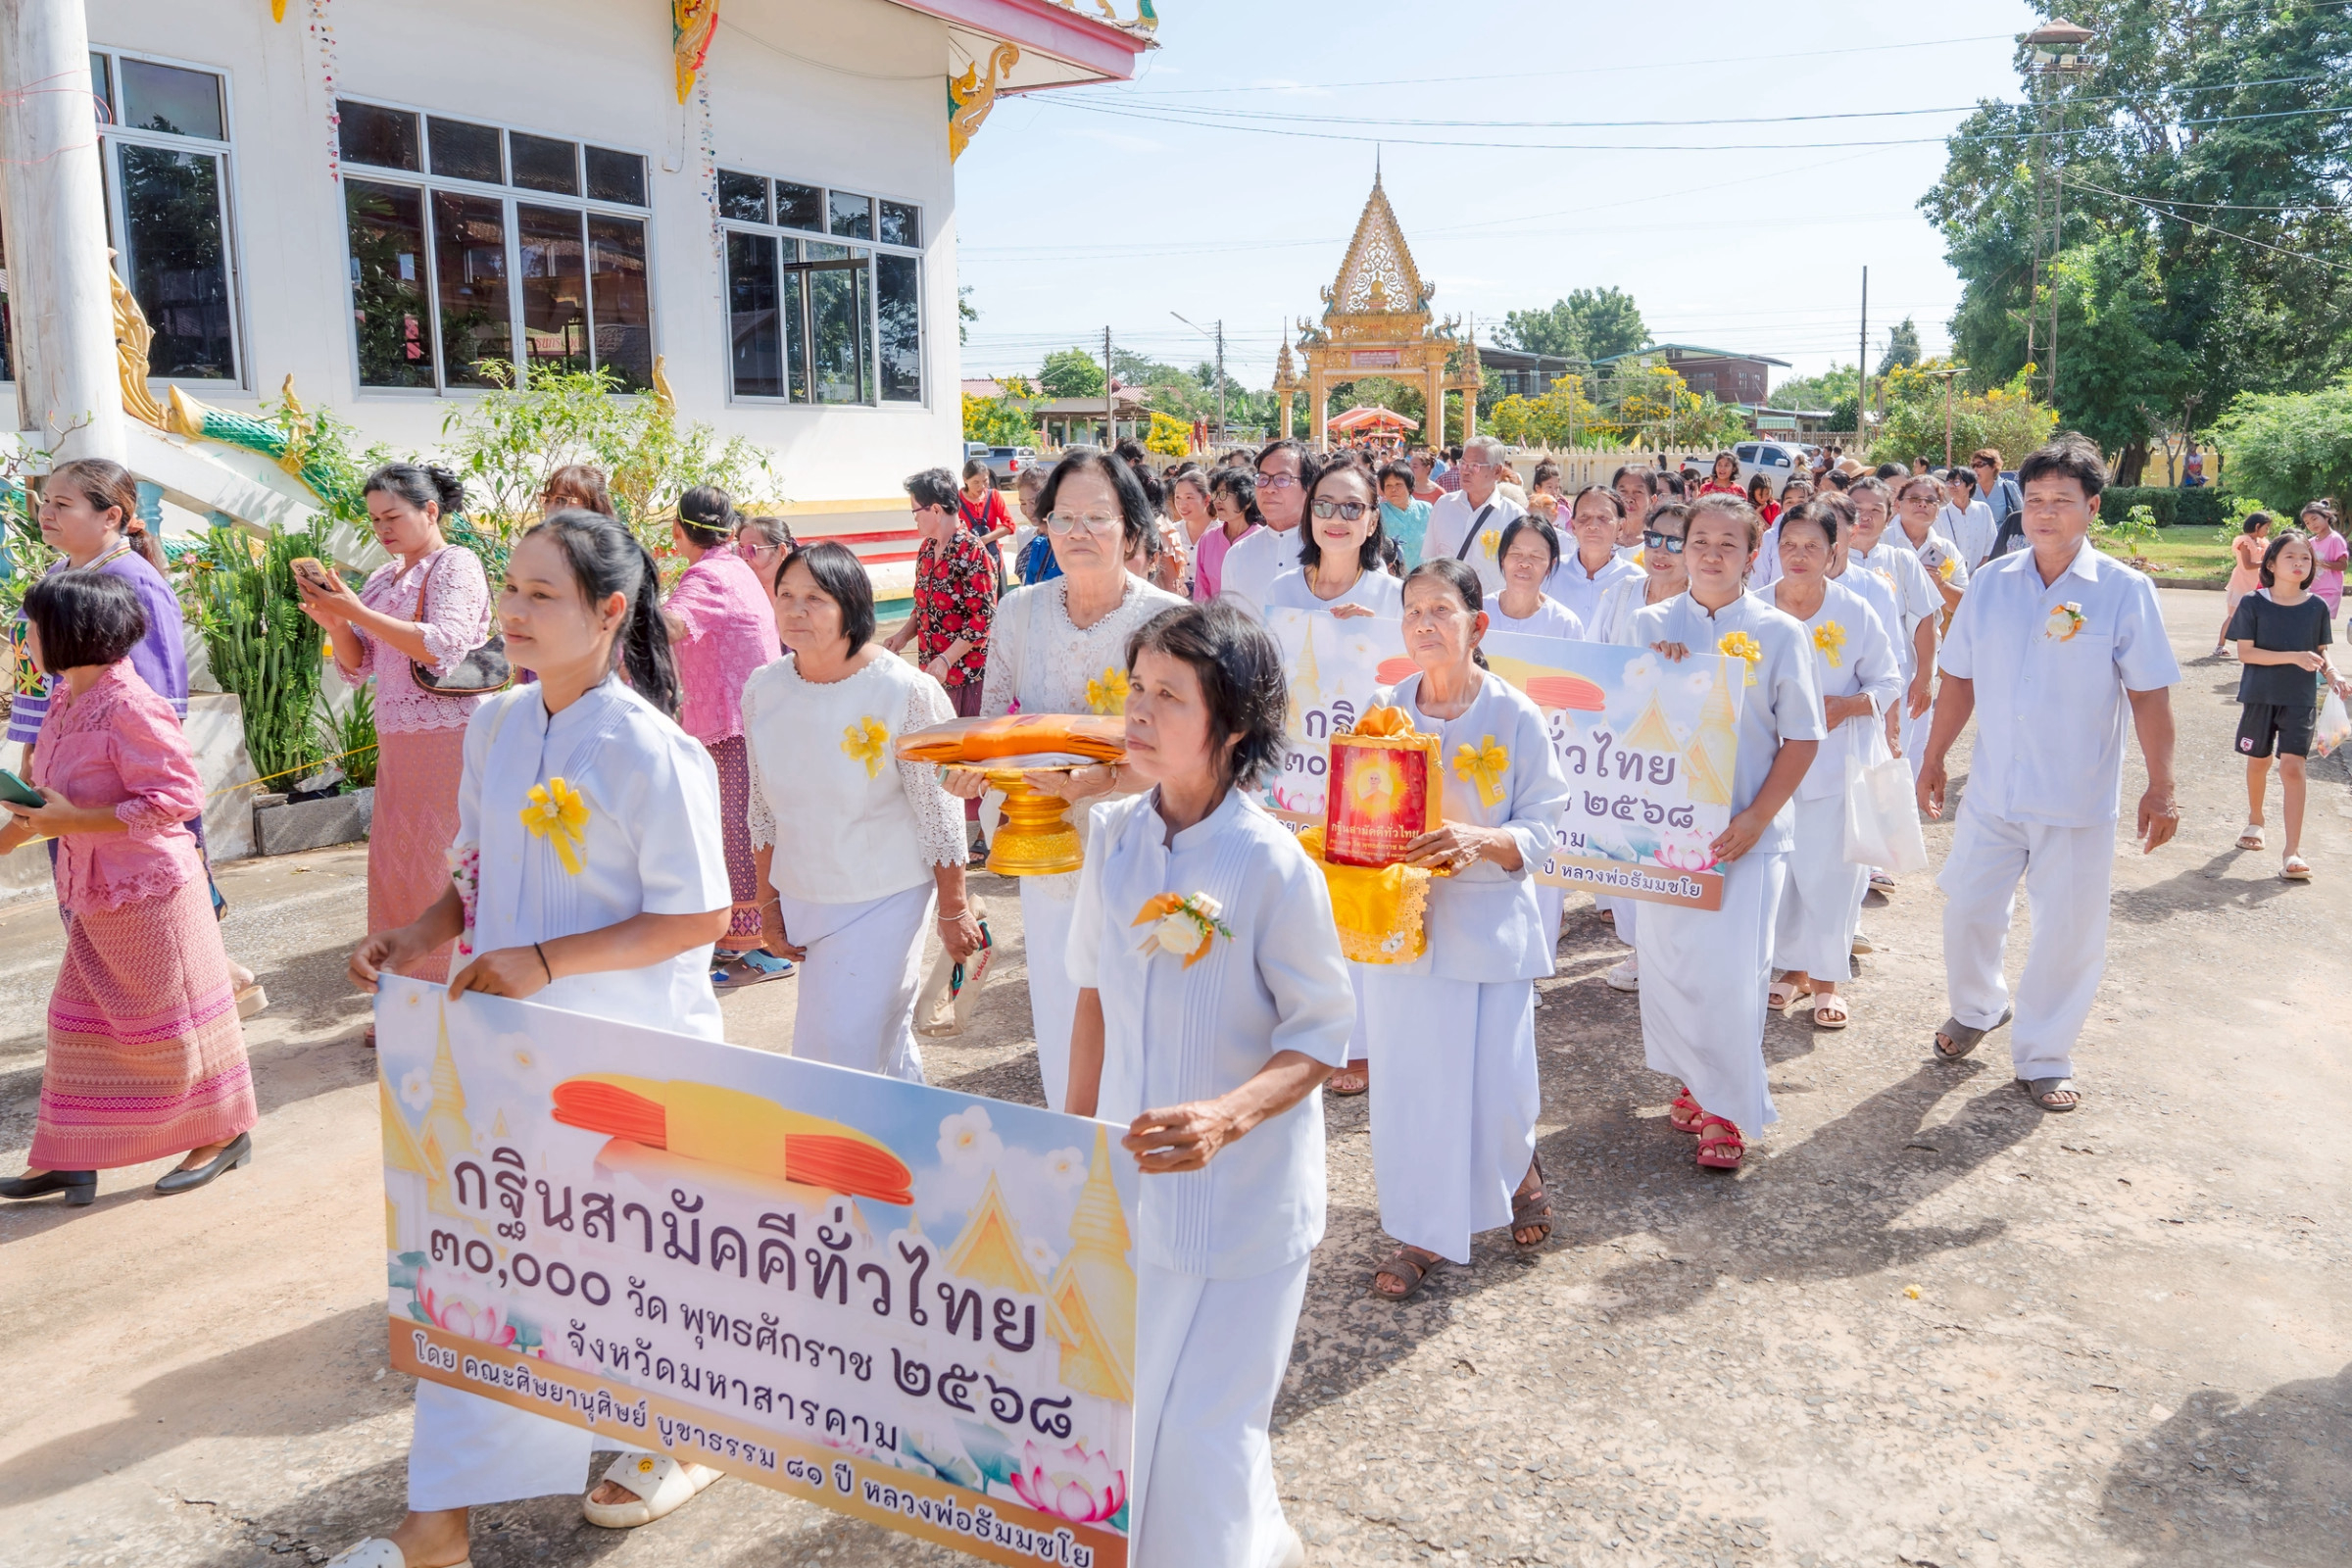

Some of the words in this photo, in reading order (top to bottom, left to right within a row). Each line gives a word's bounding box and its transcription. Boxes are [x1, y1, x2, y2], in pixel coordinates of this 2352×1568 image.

[1584, 790, 1694, 829] ๒๕๖๘
[1562, 864, 1700, 896] หลวงพ่อธัมมชโย
[971, 950, 991, 981] Yakult
[454, 1146, 1035, 1352] กฐินสามัคคีทั่วไทย
[431, 1229, 611, 1306] ๓๐,๐๐๐
[627, 1275, 667, 1324] วัด
[680, 1301, 872, 1382] พุทธศักราช
[891, 1348, 1072, 1440] ๒๕๖๘
[566, 1318, 897, 1451] จังหวัดมหาสารคาม
[415, 1333, 455, 1368] โดย
[465, 1357, 647, 1427] คณะศิษยานุศิษย์
[657, 1415, 774, 1469] บูชาธรรม
[787, 1459, 822, 1485] ๘๑
[834, 1463, 852, 1493] ปี
[863, 1480, 1090, 1568] หลวงพ่อธัมมชโย
